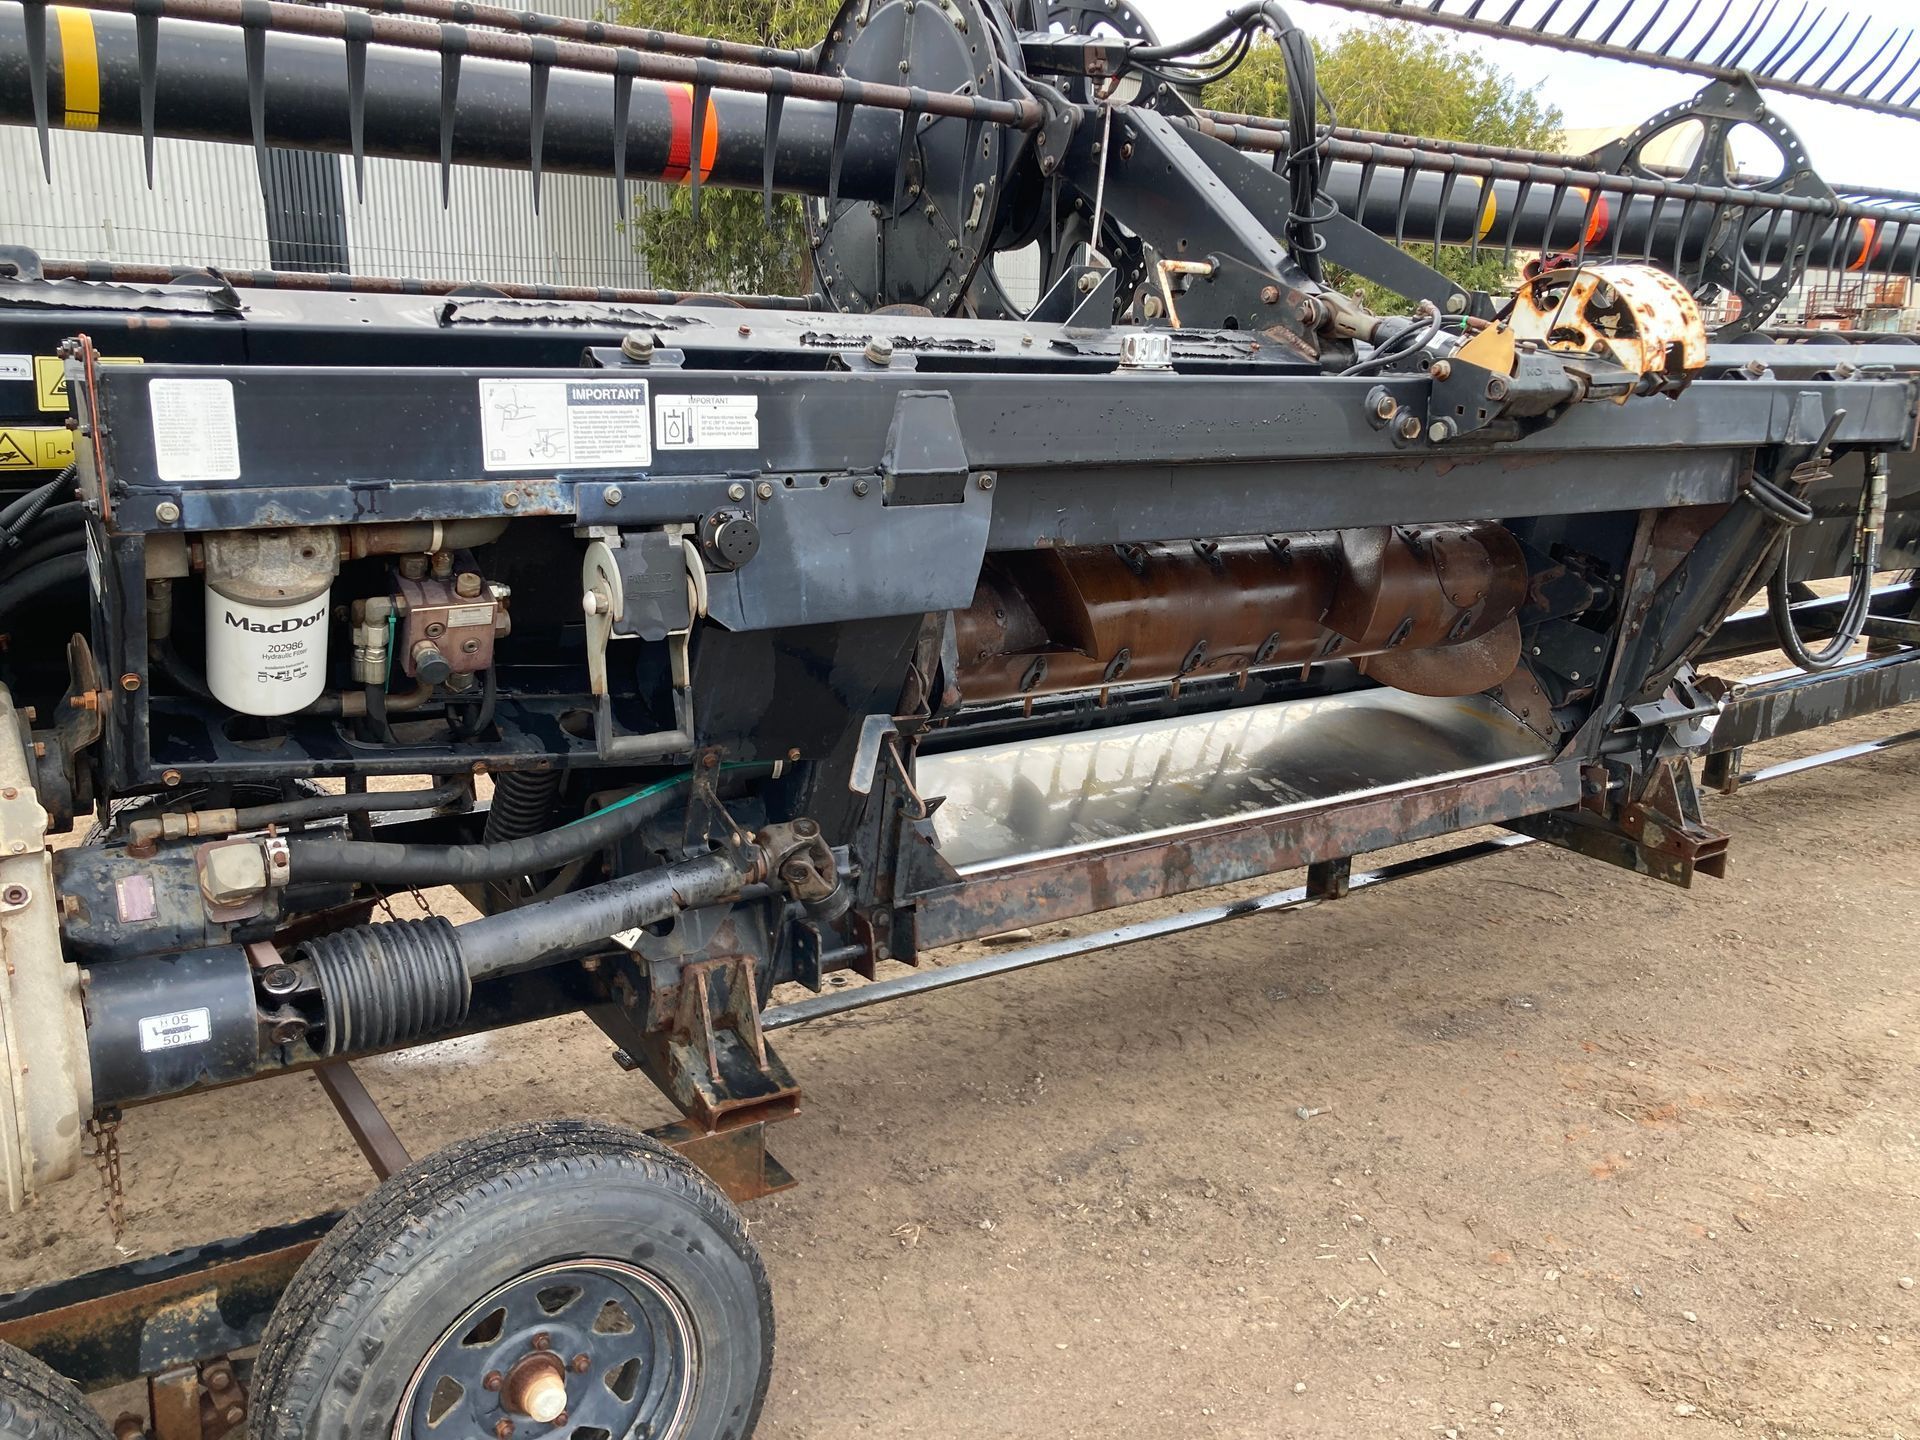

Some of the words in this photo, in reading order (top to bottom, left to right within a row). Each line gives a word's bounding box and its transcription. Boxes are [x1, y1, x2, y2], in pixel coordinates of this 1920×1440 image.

[572, 388, 641, 400] IMPORTANT
[688, 397, 728, 405] IMPORTANT
[225, 607, 325, 633] MacDon
[268, 640, 304, 653] 202986
[262, 652, 292, 661] Hydraulic
[163, 1034, 180, 1045] 50
